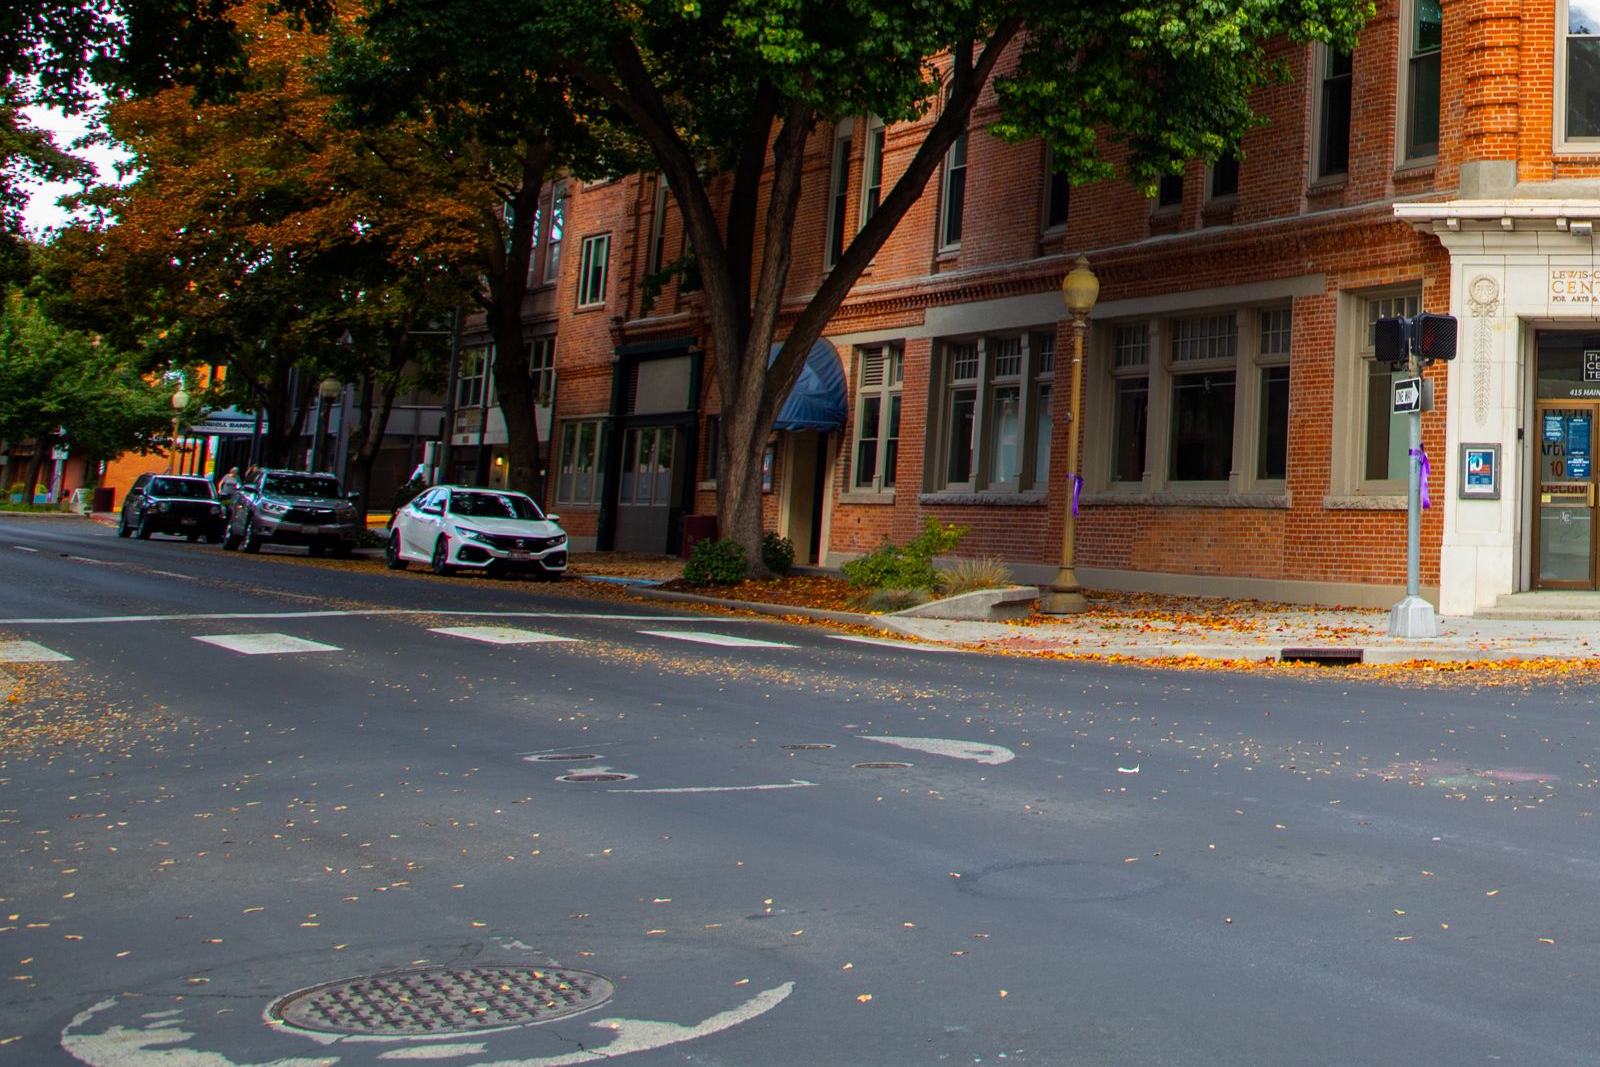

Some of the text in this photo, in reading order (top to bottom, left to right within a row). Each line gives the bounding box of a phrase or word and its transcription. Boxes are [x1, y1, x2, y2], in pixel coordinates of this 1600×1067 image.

[1552, 295, 1567, 303] FOR
[1571, 295, 1590, 303] ARTS
[1405, 390, 1413, 402] WAY
[1569, 388, 1583, 397] 415
[1469, 455, 1484, 472] 10
[1550, 460, 1564, 477] 10
